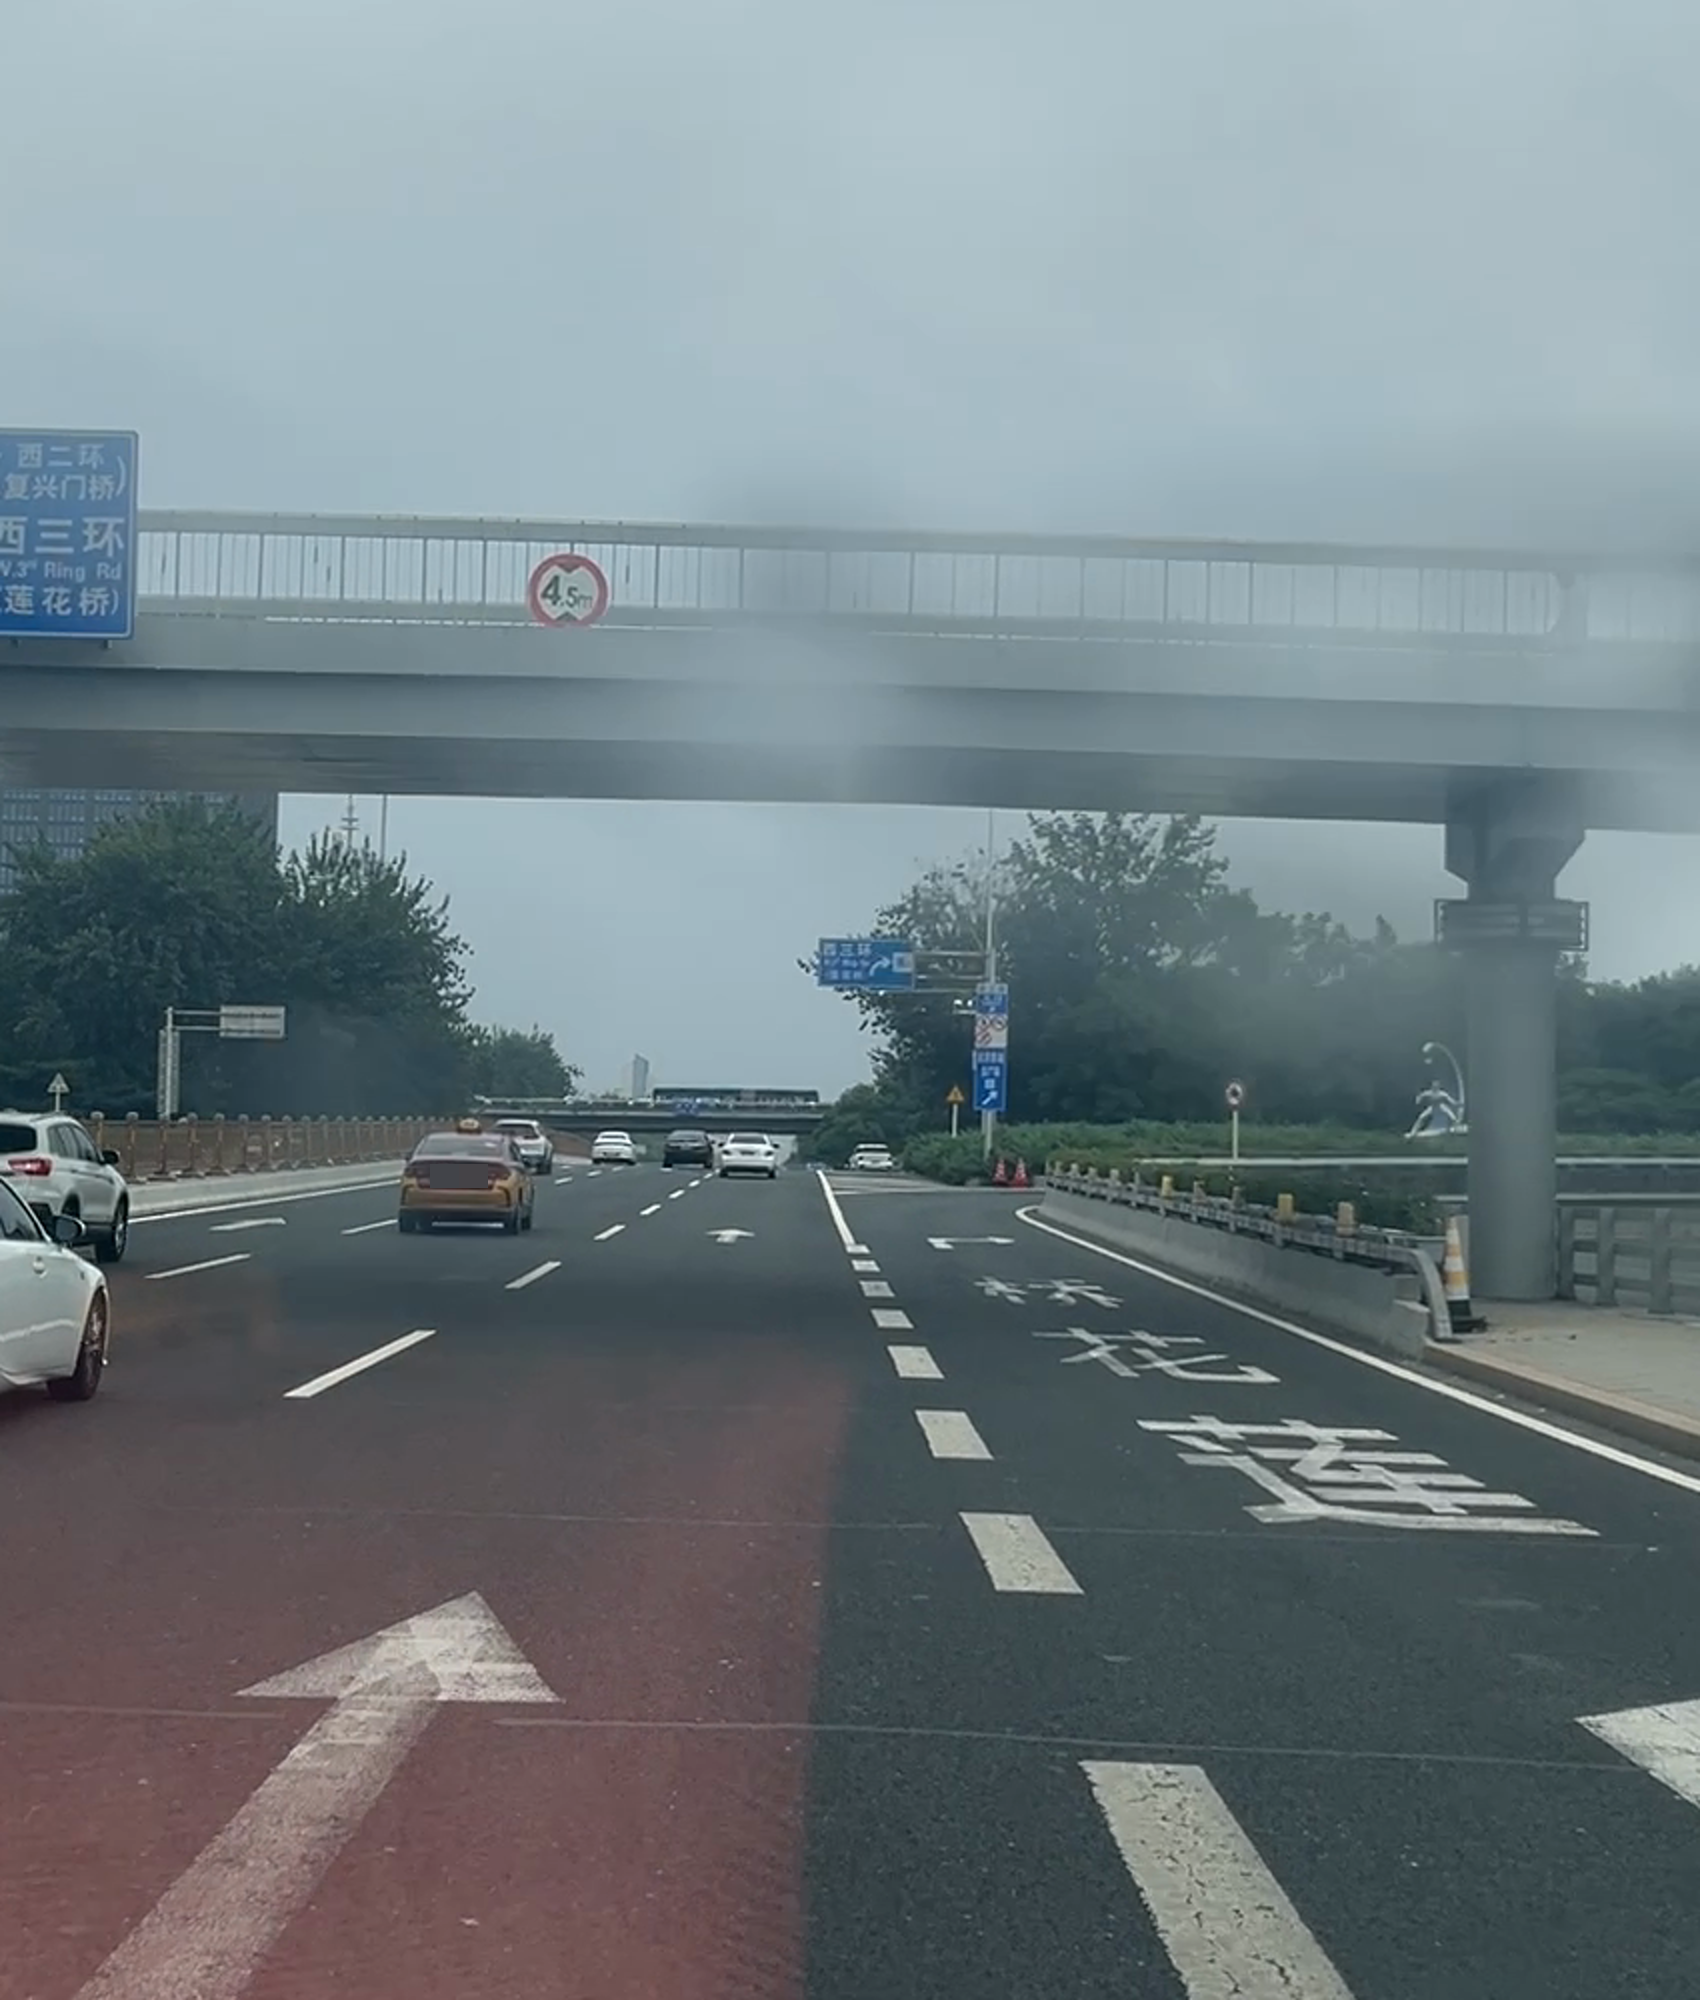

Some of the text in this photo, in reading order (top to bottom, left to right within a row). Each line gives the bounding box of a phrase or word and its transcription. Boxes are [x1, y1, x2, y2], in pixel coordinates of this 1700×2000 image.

[17, 443, 104, 470] 西二环
[0, 516, 125, 558] 西三环
[44, 561, 85, 583] Ring
[97, 562, 122, 580] Rd
[540, 575, 593, 609] 4.5m
